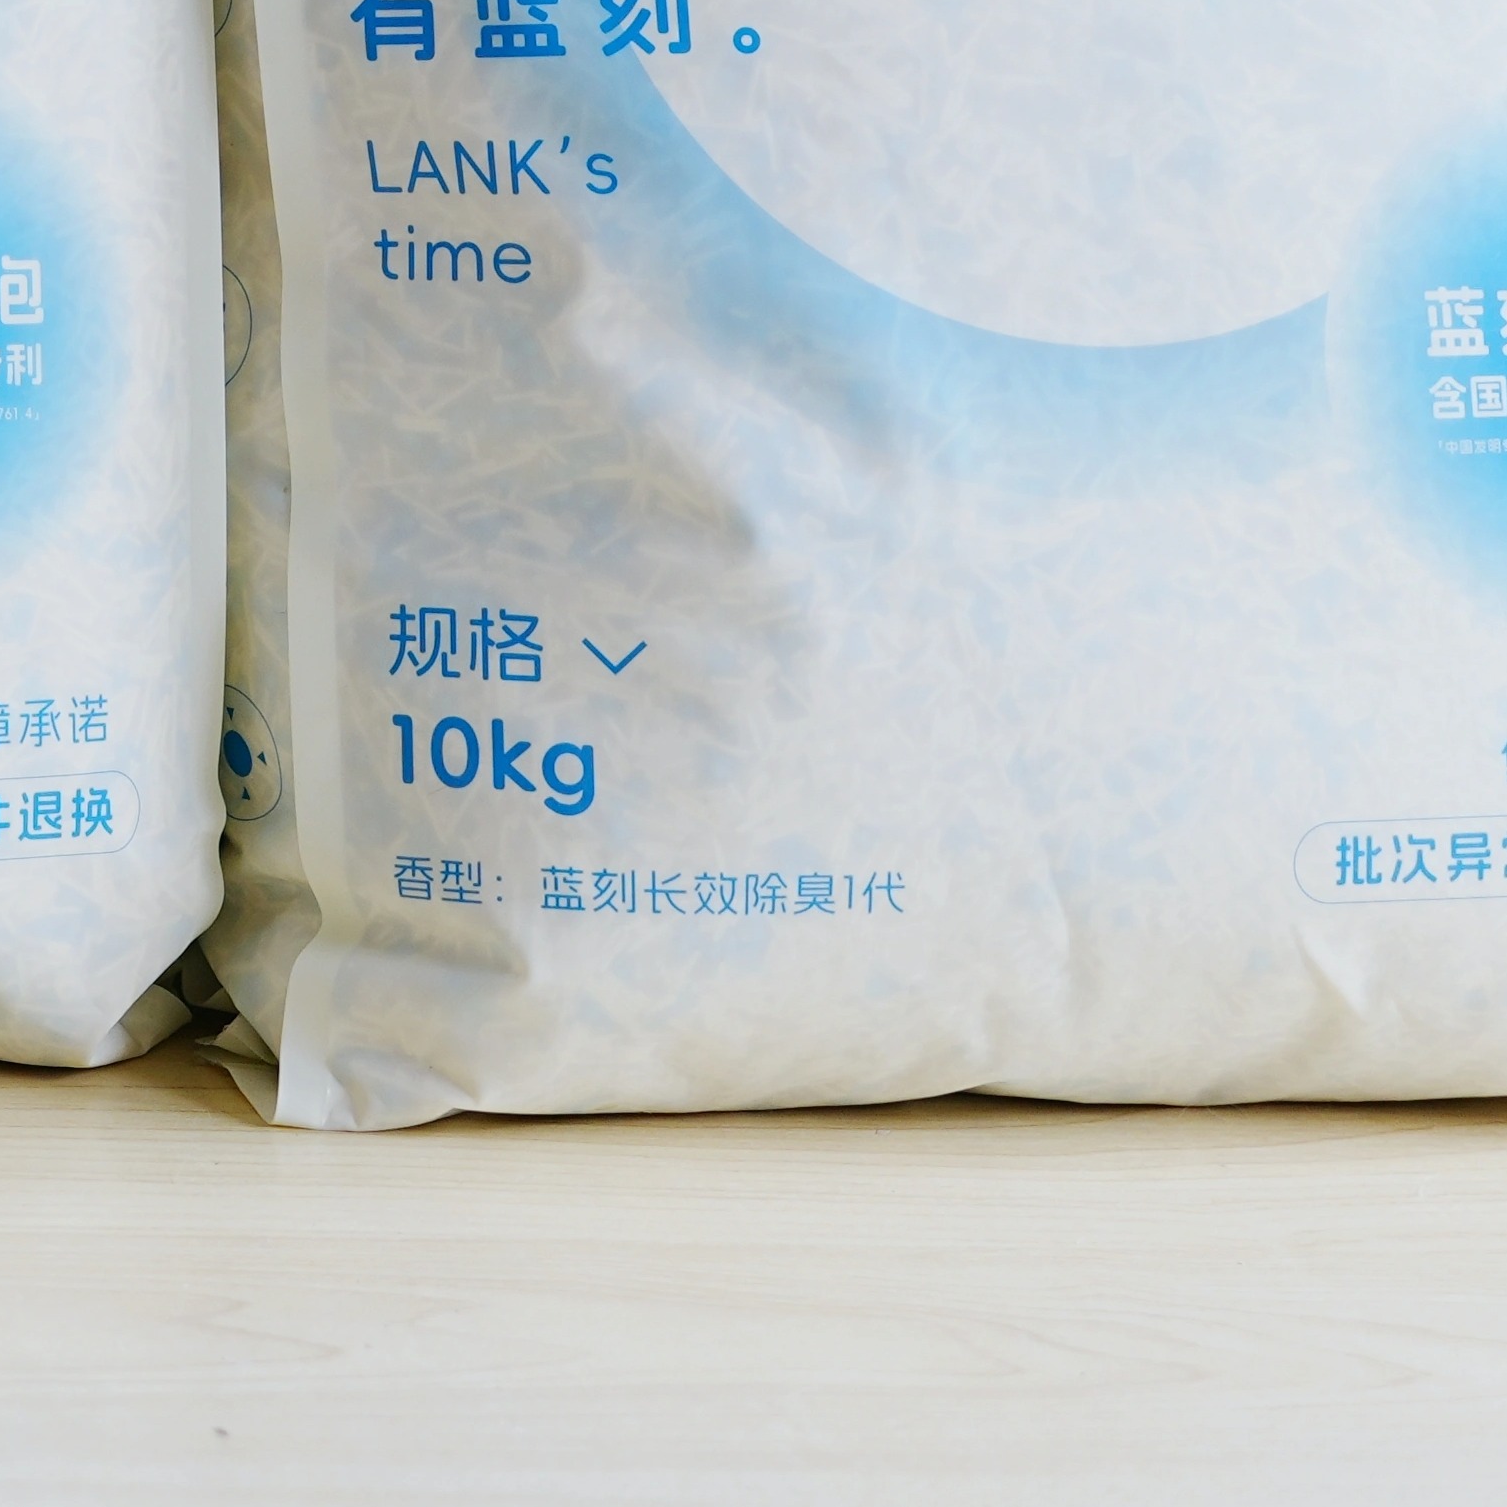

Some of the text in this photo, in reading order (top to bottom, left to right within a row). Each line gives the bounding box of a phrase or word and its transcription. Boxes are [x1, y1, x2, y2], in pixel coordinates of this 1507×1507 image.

[367, 135, 619, 195] LANK's
[374, 224, 532, 284] time
[1424, 285, 1507, 357] 蓝
[388, 603, 544, 683] 规格
[392, 713, 596, 816] 10kg
[1336, 832, 1507, 886] 批次异
